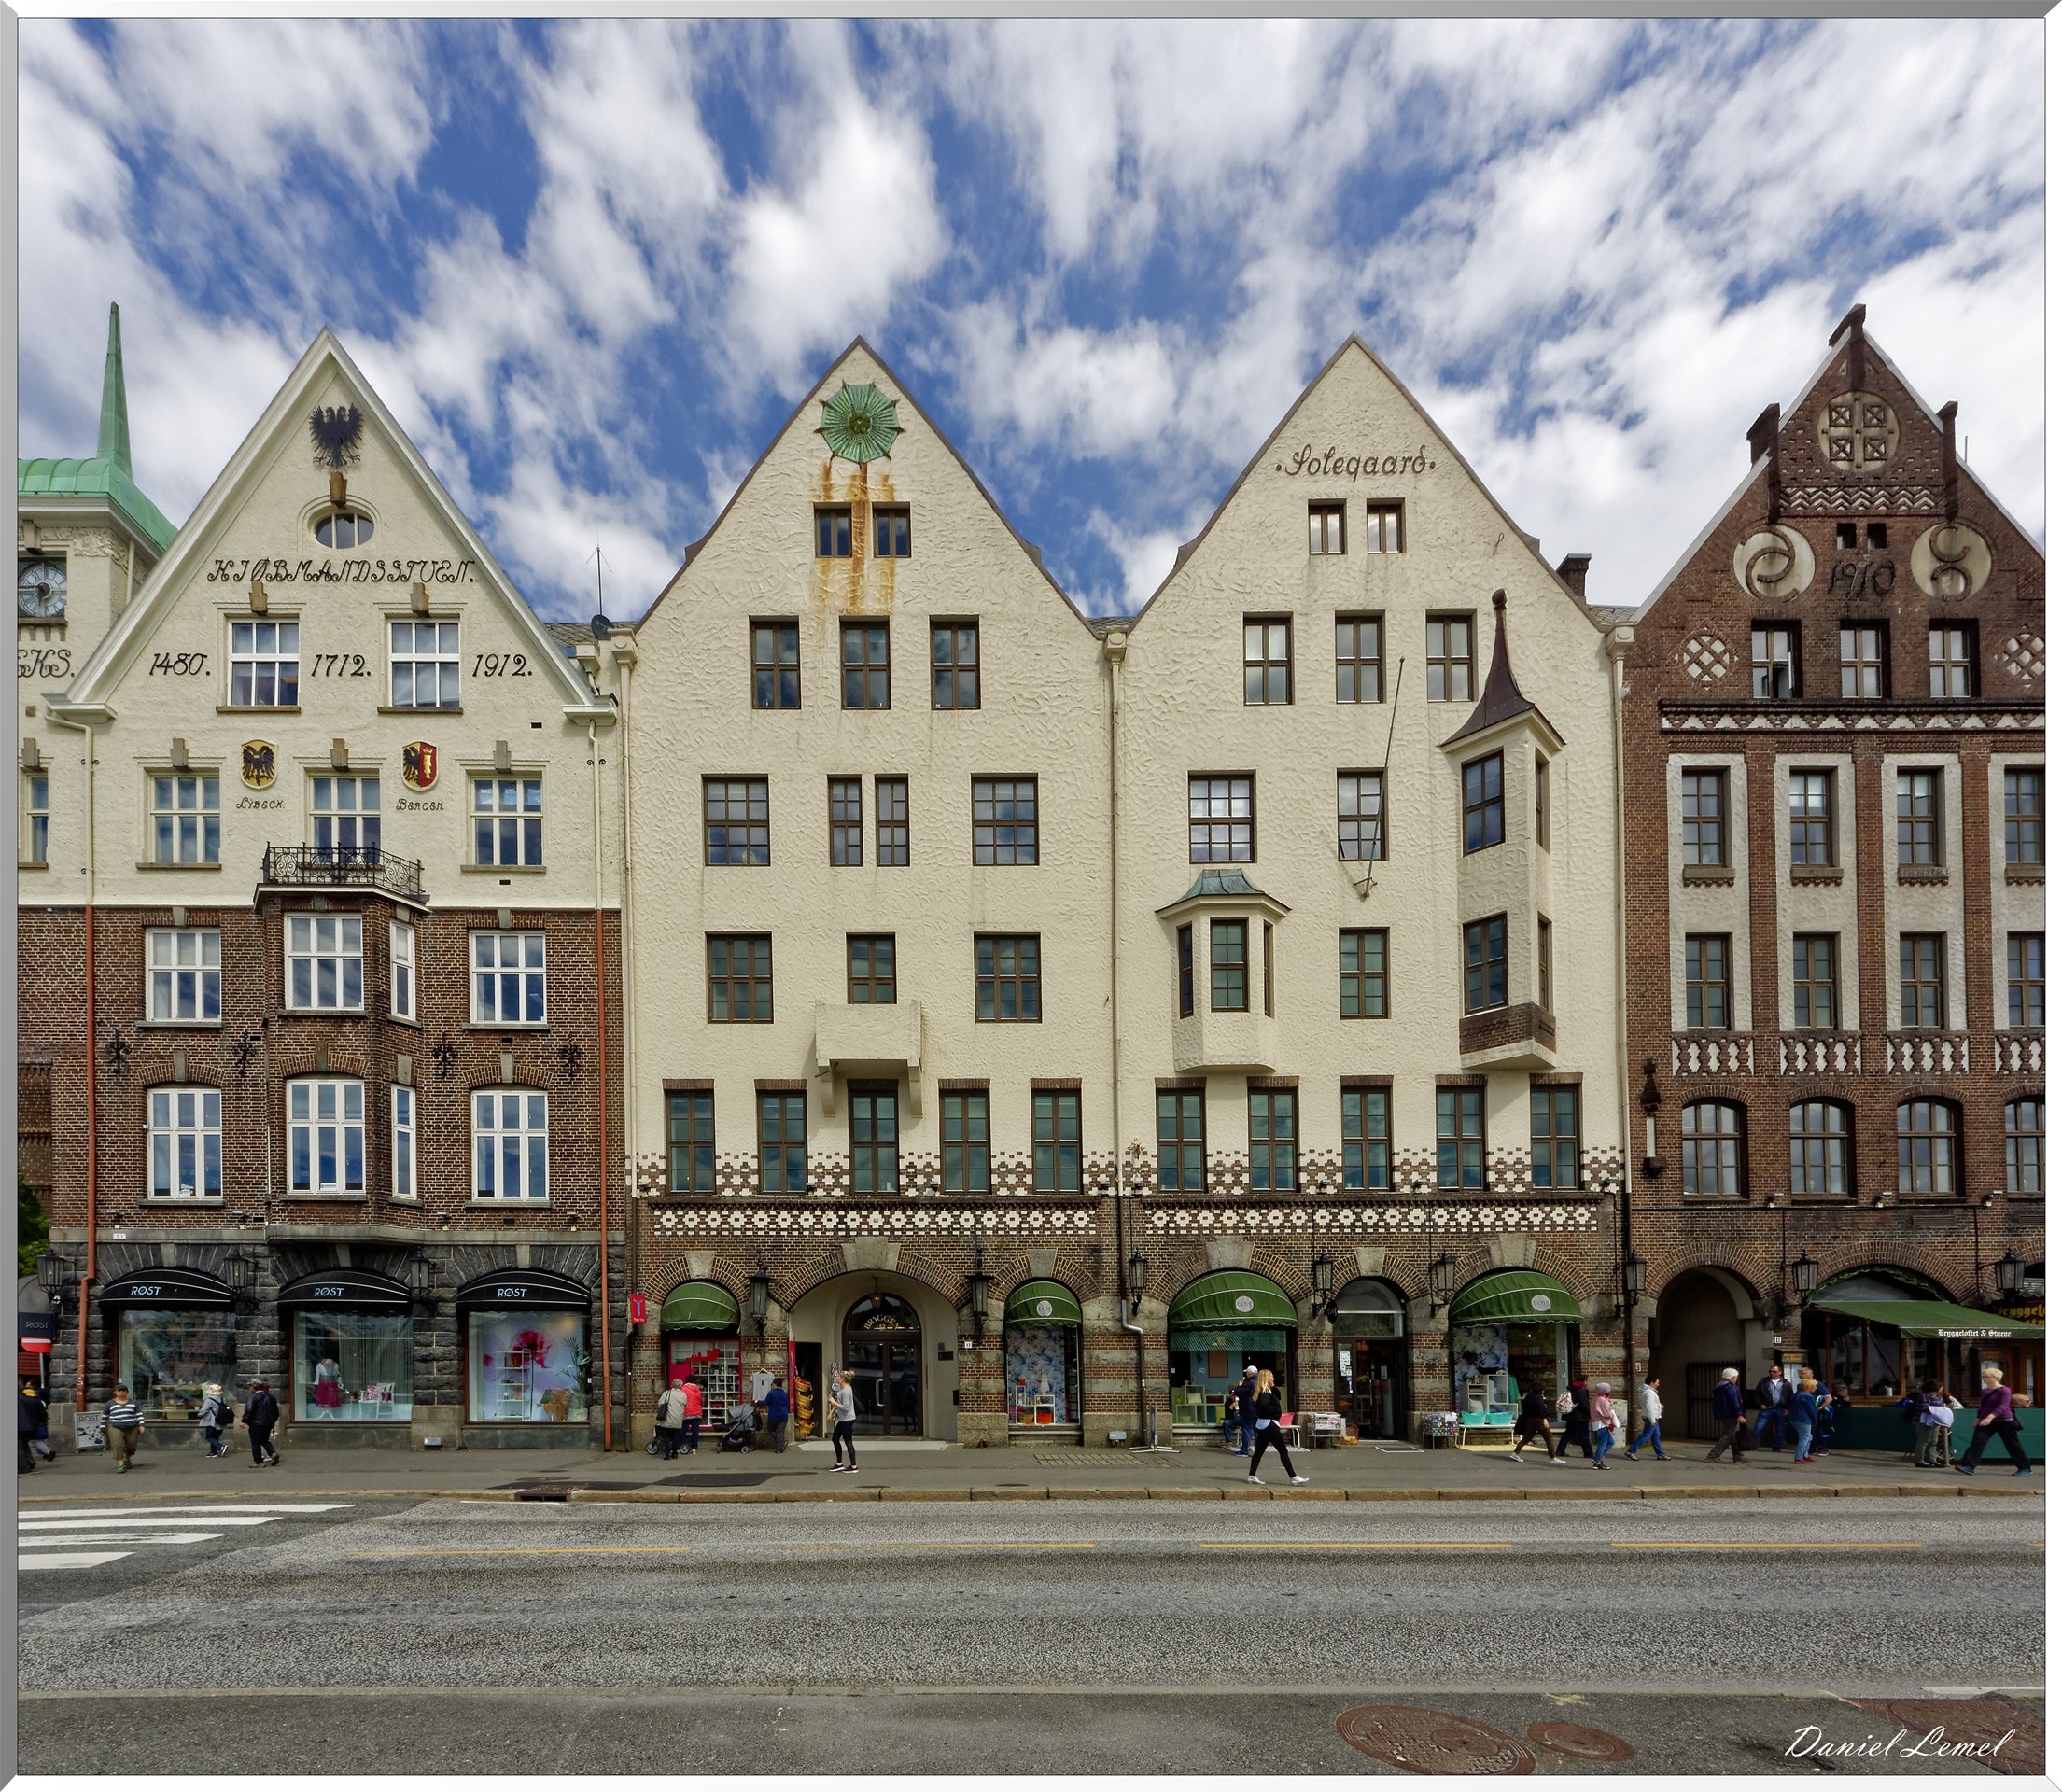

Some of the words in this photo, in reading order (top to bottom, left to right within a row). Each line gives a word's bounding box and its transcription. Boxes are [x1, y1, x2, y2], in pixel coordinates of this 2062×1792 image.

[1827, 559, 1896, 598] 1910
[131, 1286, 162, 1295] RØST
[314, 1287, 344, 1297] RØST
[497, 1288, 528, 1297] RØST
[1980, 1329, 1987, 1337] &
